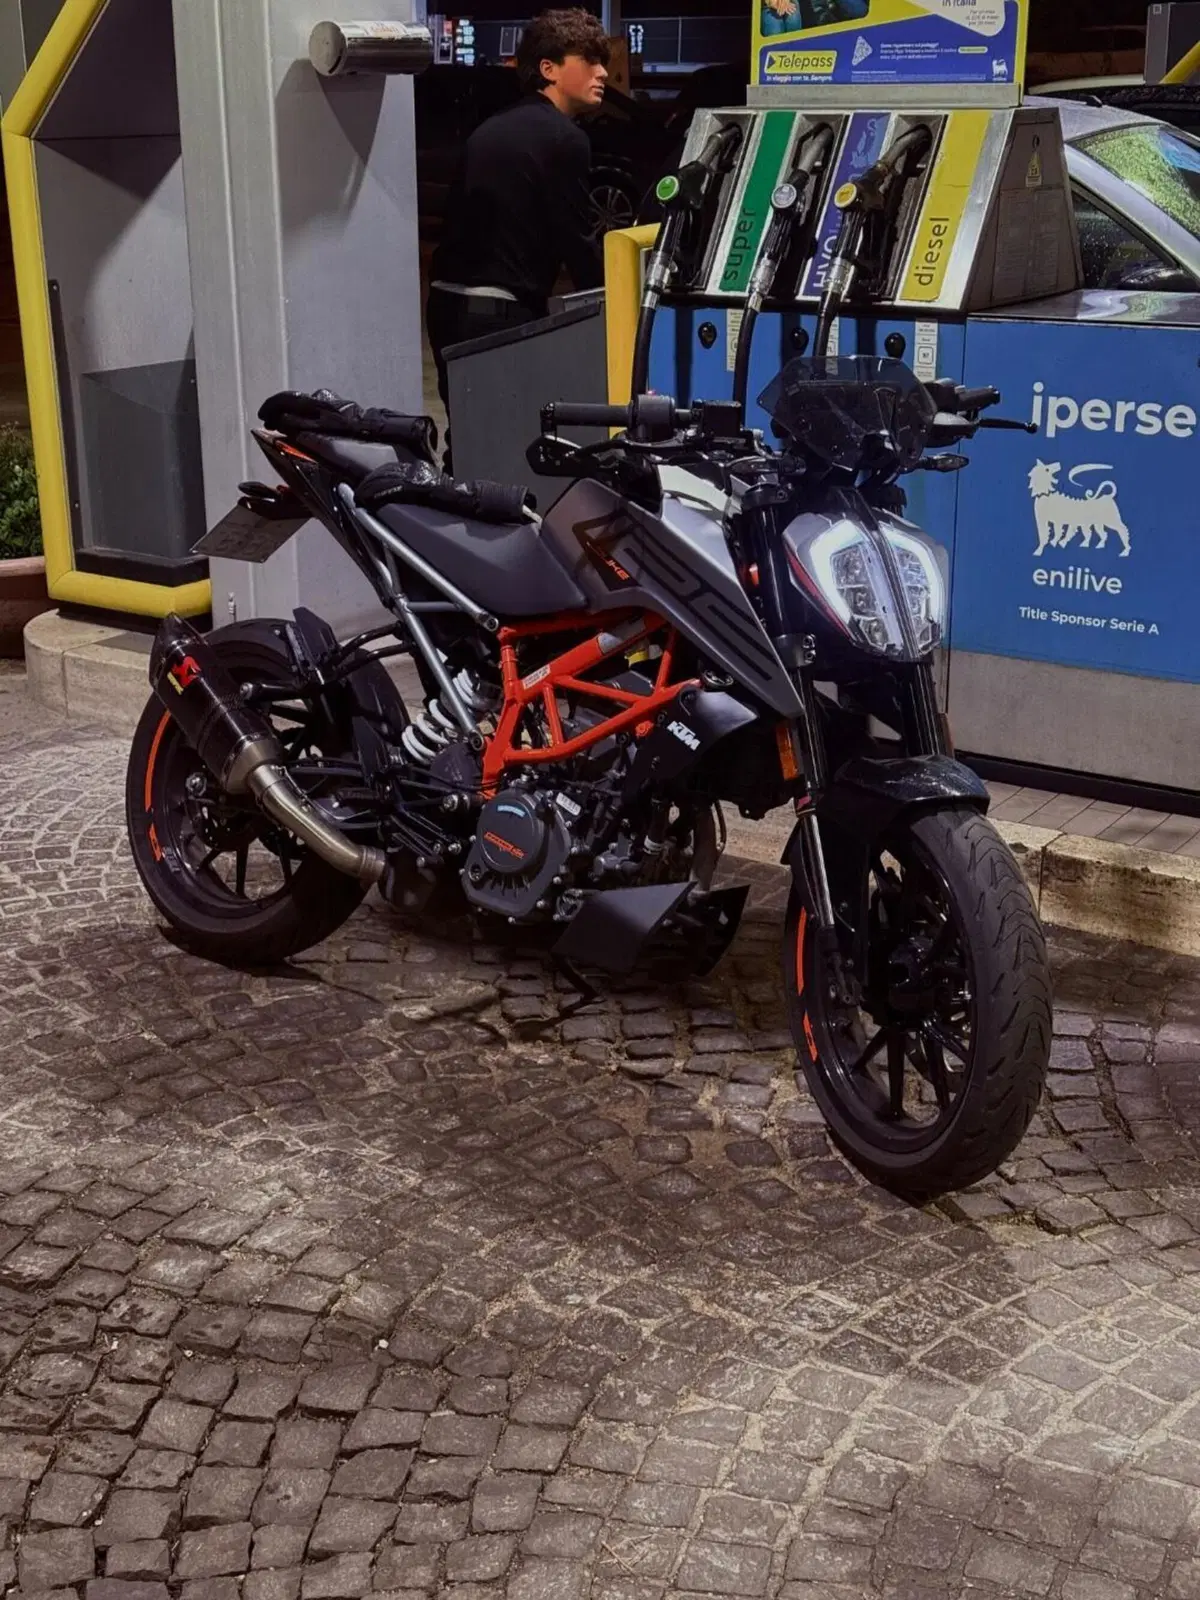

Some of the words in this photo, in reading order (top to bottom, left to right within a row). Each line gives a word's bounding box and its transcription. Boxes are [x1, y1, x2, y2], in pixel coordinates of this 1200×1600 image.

[778, 53, 833, 70] Telepass
[723, 208, 757, 282] super
[913, 217, 950, 287] diesel
[1032, 381, 1197, 438] iperse
[1032, 566, 1123, 594] enilive
[1019, 606, 1048, 621] Title
[1051, 610, 1107, 629] Sponsor
[1109, 618, 1146, 633] Serie
[1148, 623, 1160, 635] A
[667, 720, 701, 751] KTM
